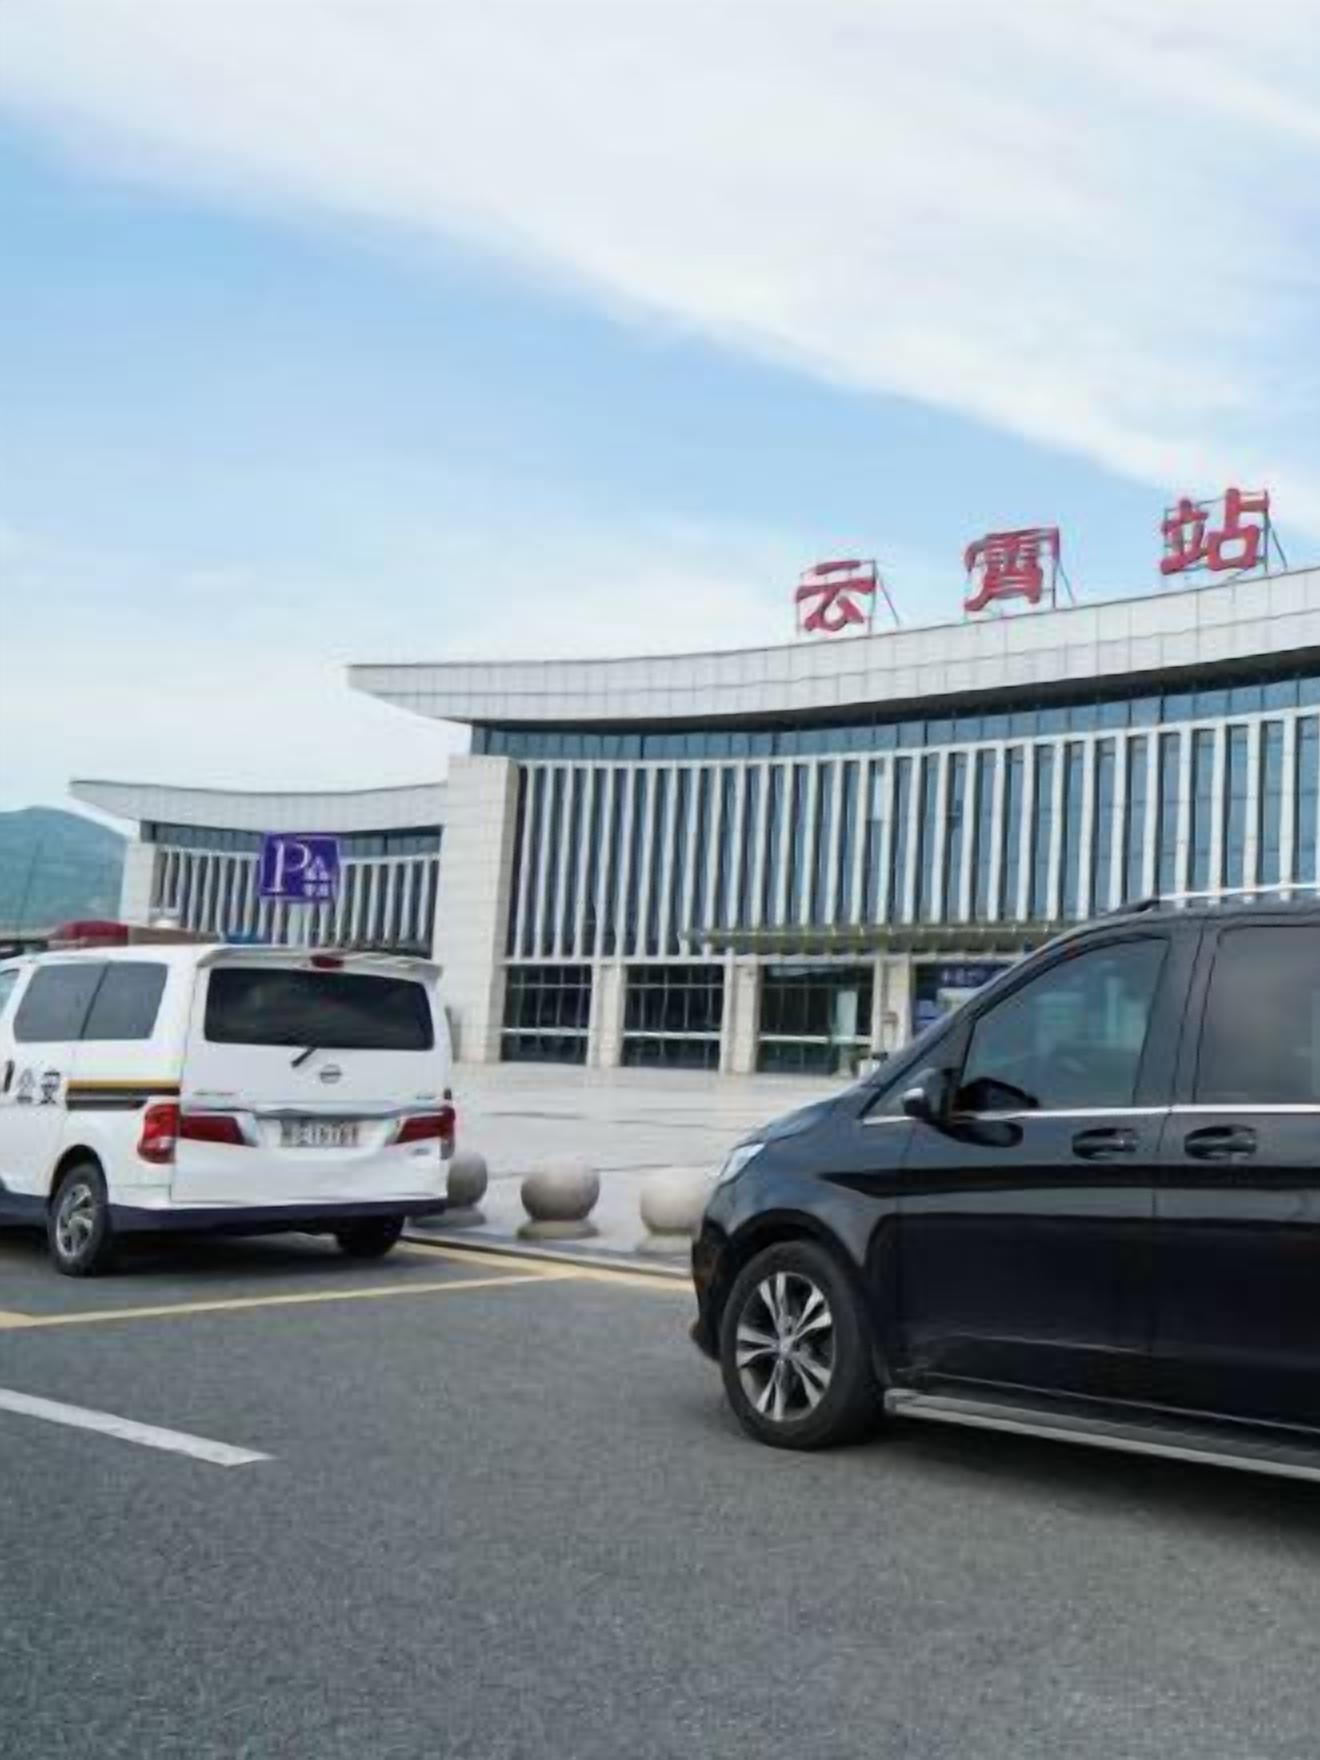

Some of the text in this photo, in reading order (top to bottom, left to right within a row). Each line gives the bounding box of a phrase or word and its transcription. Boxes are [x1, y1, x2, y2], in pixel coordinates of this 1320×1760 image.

[795, 488, 1270, 631] 云霄站
[267, 840, 312, 893] P
